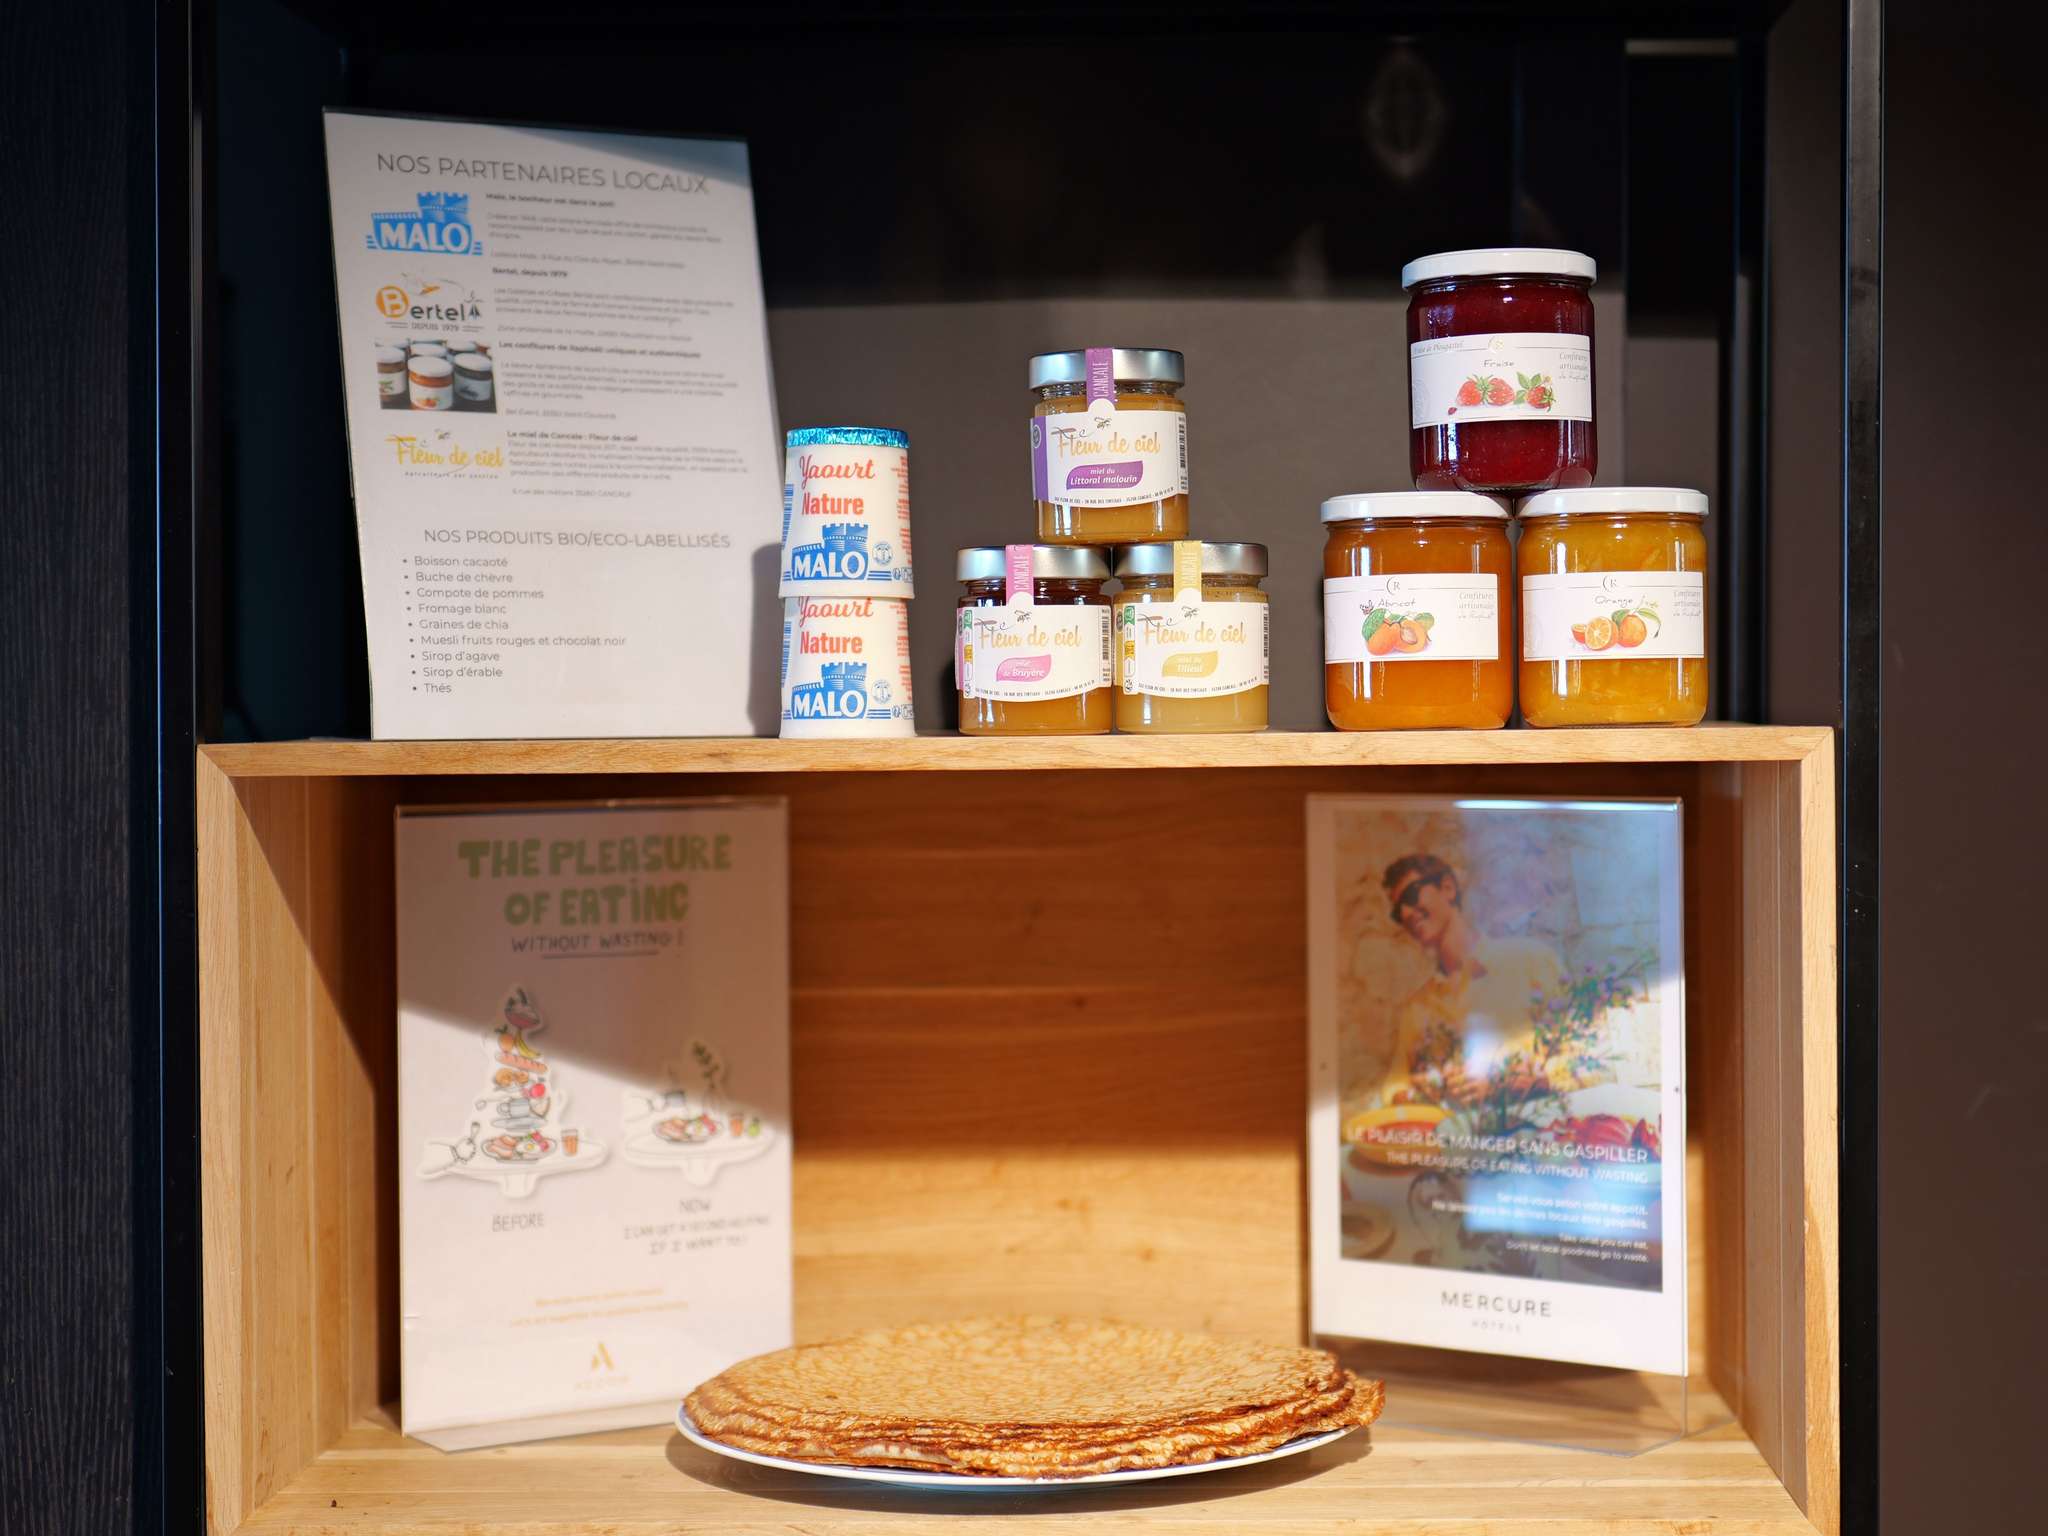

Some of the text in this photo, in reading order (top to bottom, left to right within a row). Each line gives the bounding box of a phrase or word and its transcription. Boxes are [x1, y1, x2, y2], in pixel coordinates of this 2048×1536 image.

[377, 153, 709, 194] NOS PARTENAIRES LOCAUX
[379, 223, 469, 251] MALO
[376, 285, 465, 321] Bertel
[1483, 359, 1515, 368] Fraise
[1092, 361, 1109, 398] CANCALE
[1051, 427, 1161, 459] Fleur de ciel
[449, 444, 468, 465] de
[475, 446, 503, 468] ciel
[799, 453, 876, 489] Yaourt
[1070, 474, 1138, 486] Littoral malouin
[1090, 467, 1116, 475] miel du
[801, 492, 865, 516] Nature
[424, 529, 731, 549] NOS PRODUITS BIO/ECO-LABELLISÉS
[414, 555, 508, 568] Boisson cacaoté
[793, 551, 866, 580] MALO
[1013, 555, 1031, 591] CANCALE
[415, 571, 456, 582] Buche
[457, 571, 472, 582] de
[417, 587, 544, 601] Compote de pommes
[1378, 598, 1416, 608] Abricot
[1594, 595, 1634, 609] Orange
[418, 603, 507, 616] Fromage blanc
[798, 596, 874, 628] Yaourt
[419, 619, 509, 630] Graines de chia
[974, 618, 1081, 649] Fleur de ciel
[1137, 615, 1247, 646] Fleur de ciel
[420, 635, 626, 648] Muesli fruits rouges et chocolat noir
[799, 631, 863, 655] Nature
[422, 651, 452, 664] Sirop
[423, 667, 453, 679] Sirop
[424, 682, 452, 693] Thés
[793, 690, 865, 718] MALO
[458, 833, 734, 879] THE PLEASURE
[504, 890, 550, 927] OF
[510, 935, 591, 954] WITHOUT
[599, 930, 672, 949] WASTING
[1347, 1126, 1649, 1164] LE PLAISIR DE MANGER SANS GASPILLER
[1387, 1151, 1649, 1185] THE PLEASURE OF EATING WITHOUT WASTING
[679, 1198, 712, 1215] NOW
[492, 1212, 545, 1232] BEFORE
[1441, 1290, 1553, 1318] MERCURE
